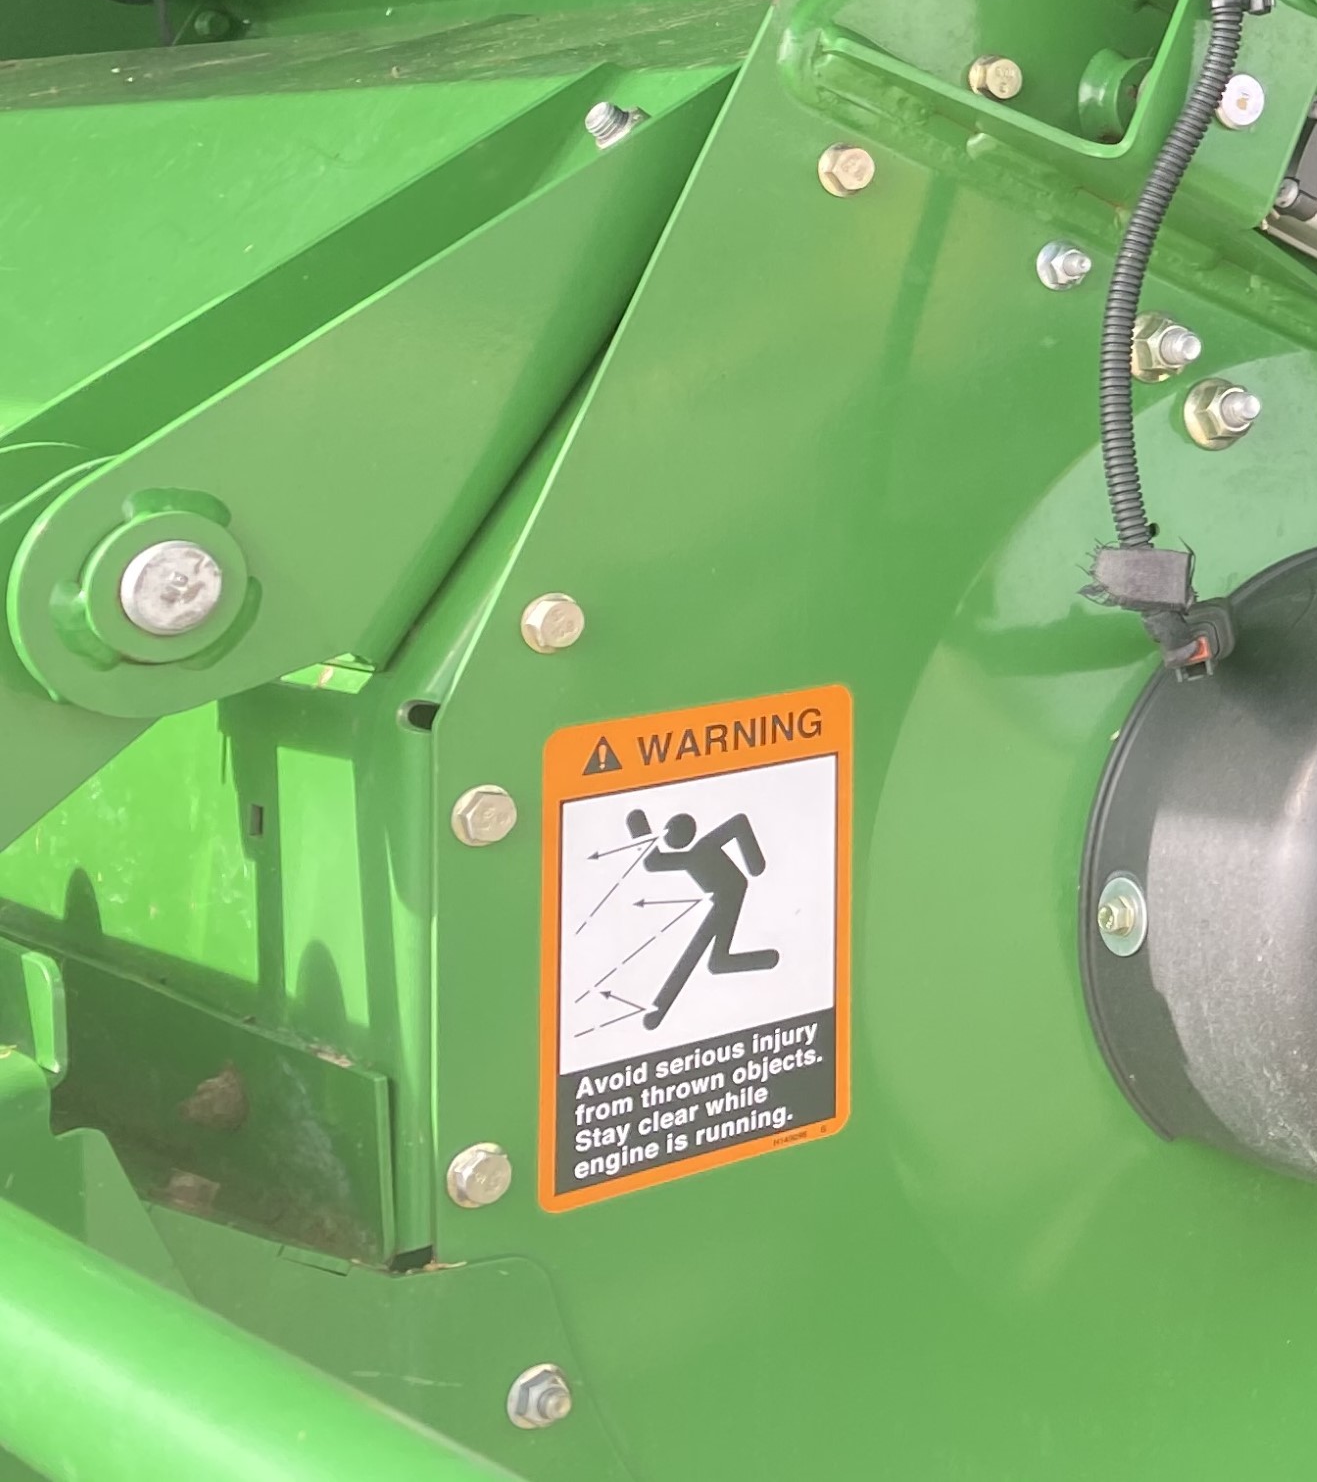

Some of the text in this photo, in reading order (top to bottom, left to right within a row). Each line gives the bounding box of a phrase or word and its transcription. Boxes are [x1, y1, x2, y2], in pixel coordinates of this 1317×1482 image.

[637, 708, 822, 766] WARNING
[575, 1048, 823, 1126] from thrown objects.
[576, 1022, 818, 1099] Avoid serious injury
[574, 1142, 659, 1179] engine
[666, 1133, 688, 1154] is
[695, 1106, 793, 1146] running.
[575, 1085, 768, 1152] Stay clear while
